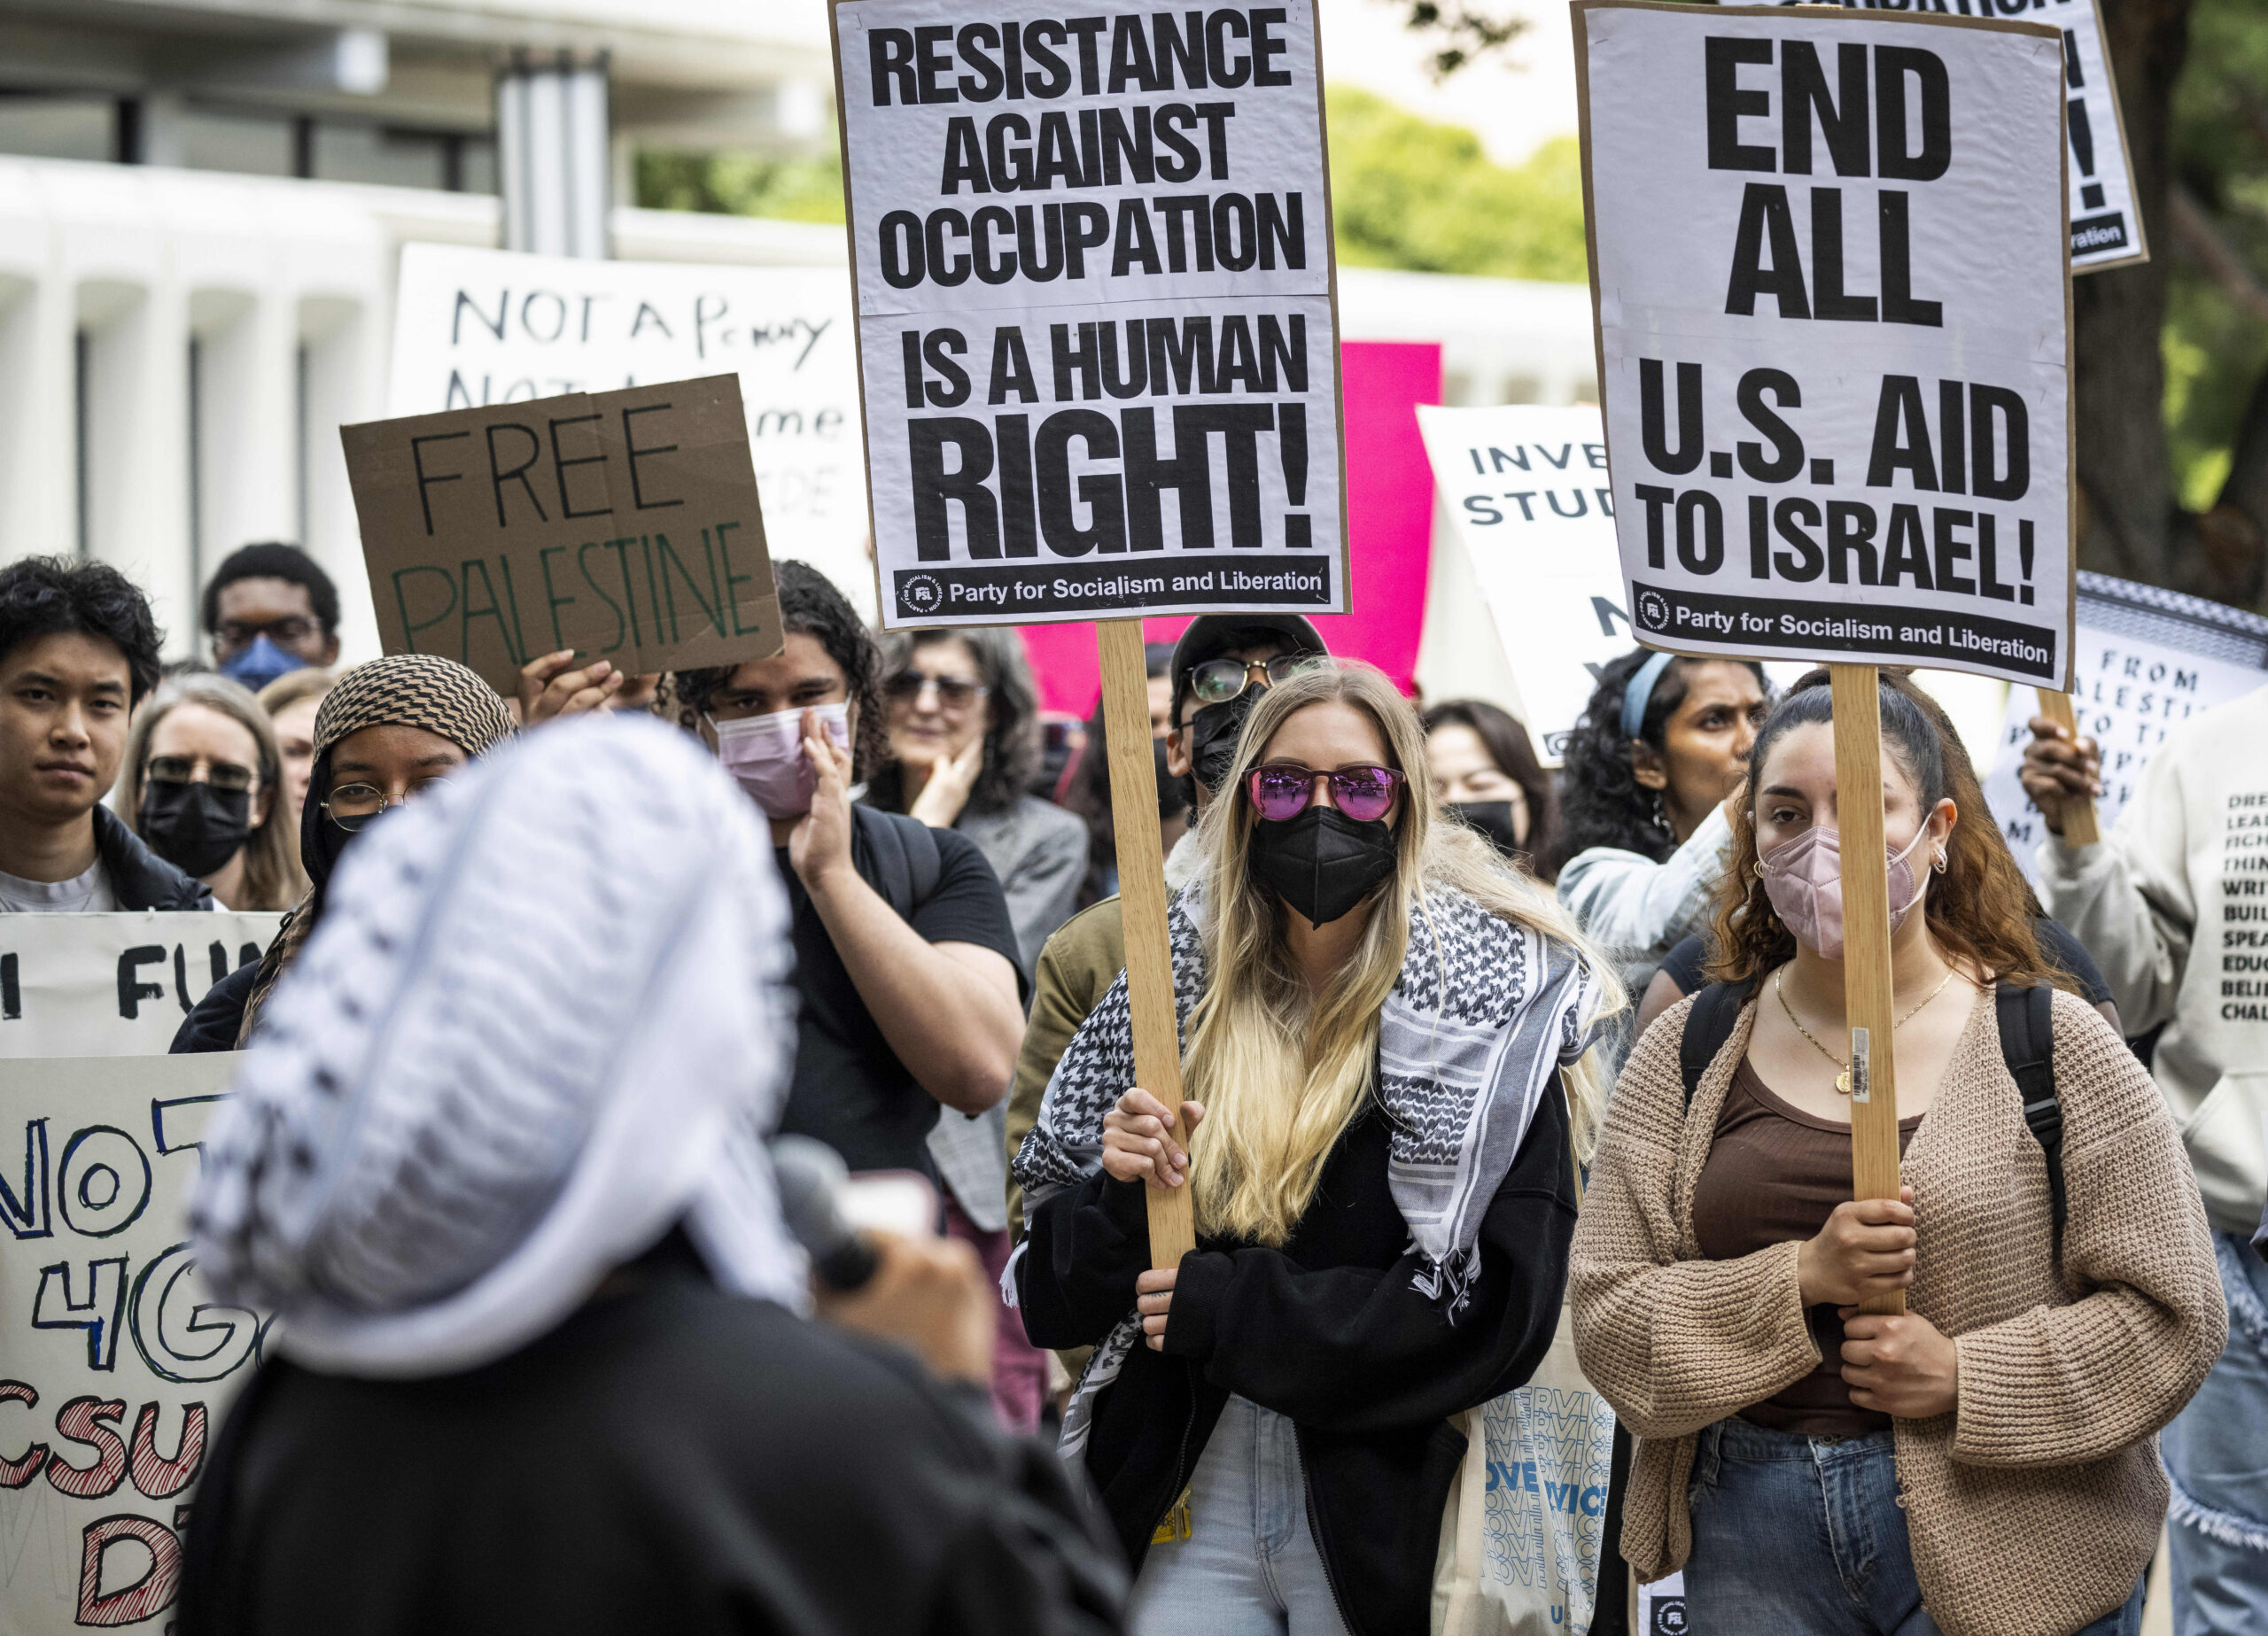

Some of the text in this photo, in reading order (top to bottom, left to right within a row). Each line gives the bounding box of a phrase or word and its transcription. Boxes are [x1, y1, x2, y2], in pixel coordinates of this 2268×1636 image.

[867, 8, 1292, 106] RESISTANCE
[941, 102, 1235, 195] AGAINST
[1705, 35, 1952, 182] END
[878, 191, 1306, 289] OCCUPATION
[1724, 182, 1943, 328] ALL
[2071, 226, 2122, 250] ration
[450, 287, 612, 346] NOT
[630, 301, 674, 338] A
[901, 314, 1309, 408] IS A HUMAN
[411, 403, 685, 537] FREE
[1469, 442, 1608, 475] INVE
[1639, 357, 2030, 501] U.S. AID
[907, 403, 1312, 562] RIGHT!
[950, 570, 1322, 606] Party for Socialism and Liberation
[1635, 483, 2035, 607] TO ISRAEL!
[392, 523, 759, 666] PALESTINE
[1675, 605, 1734, 633] Party
[1740, 612, 1774, 633] for
[1779, 614, 1893, 641] Socialism
[1899, 624, 1943, 646] and
[1948, 627, 2048, 664] Liberation
[2101, 648, 2200, 694] FROM
[2223, 930, 2268, 947] SPEA
[2224, 904, 2268, 921] BUIL
[2221, 1003, 2268, 1020] CHAL
